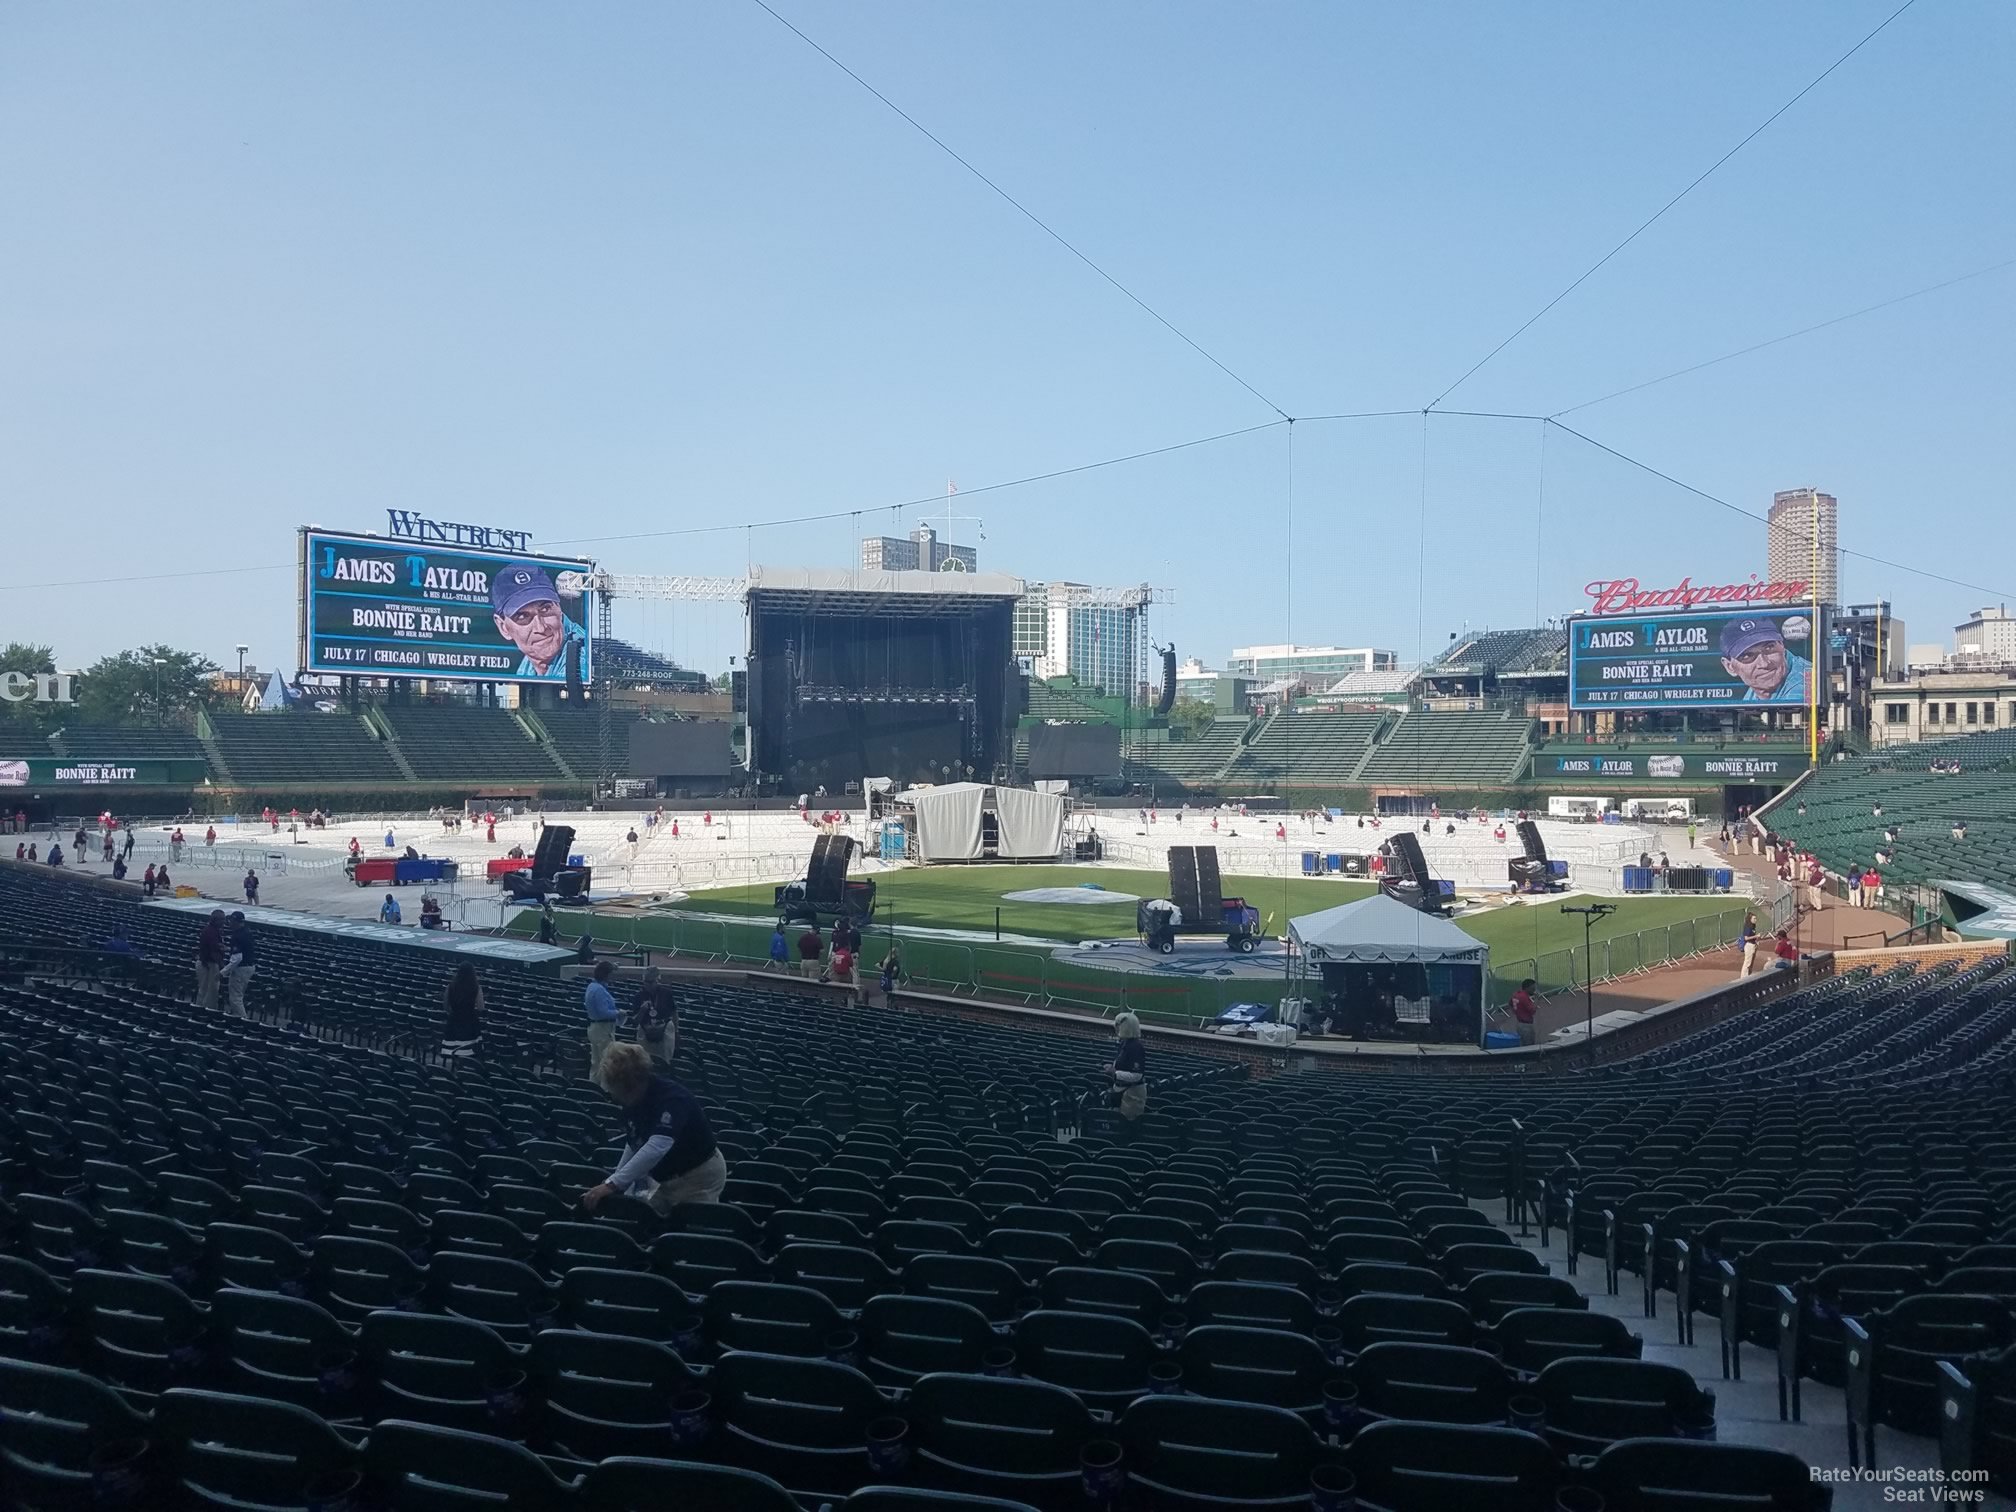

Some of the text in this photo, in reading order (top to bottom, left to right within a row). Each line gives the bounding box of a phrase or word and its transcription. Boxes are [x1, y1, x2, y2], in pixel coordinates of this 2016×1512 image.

[387, 508, 533, 551] WINTRUST
[320, 547, 488, 593] JAMES TAYLOR
[442, 593, 472, 602] ALL-STAR
[473, 595, 489, 603] BAND
[1584, 573, 1809, 613] Budweiser
[401, 604, 423, 612] SPECIAL
[424, 606, 441, 614] GUEST
[353, 608, 471, 634] BONNIE RAITT
[1580, 623, 1708, 648] JAMES TAYLOR
[323, 647, 510, 668] JULY 17 CHICAGO WRIGLEY FIELD
[1603, 664, 1693, 679] BONNIE RAITT
[1588, 689, 1733, 701] JULY 17 CHICAGO WRIGLEY FIELD
[1557, 757, 1590, 772] JAMES
[1594, 756, 1633, 771] TAYLOR
[1706, 762, 1779, 772] BONNIE RAITT
[55, 768, 136, 779] BONNIE RAITT
